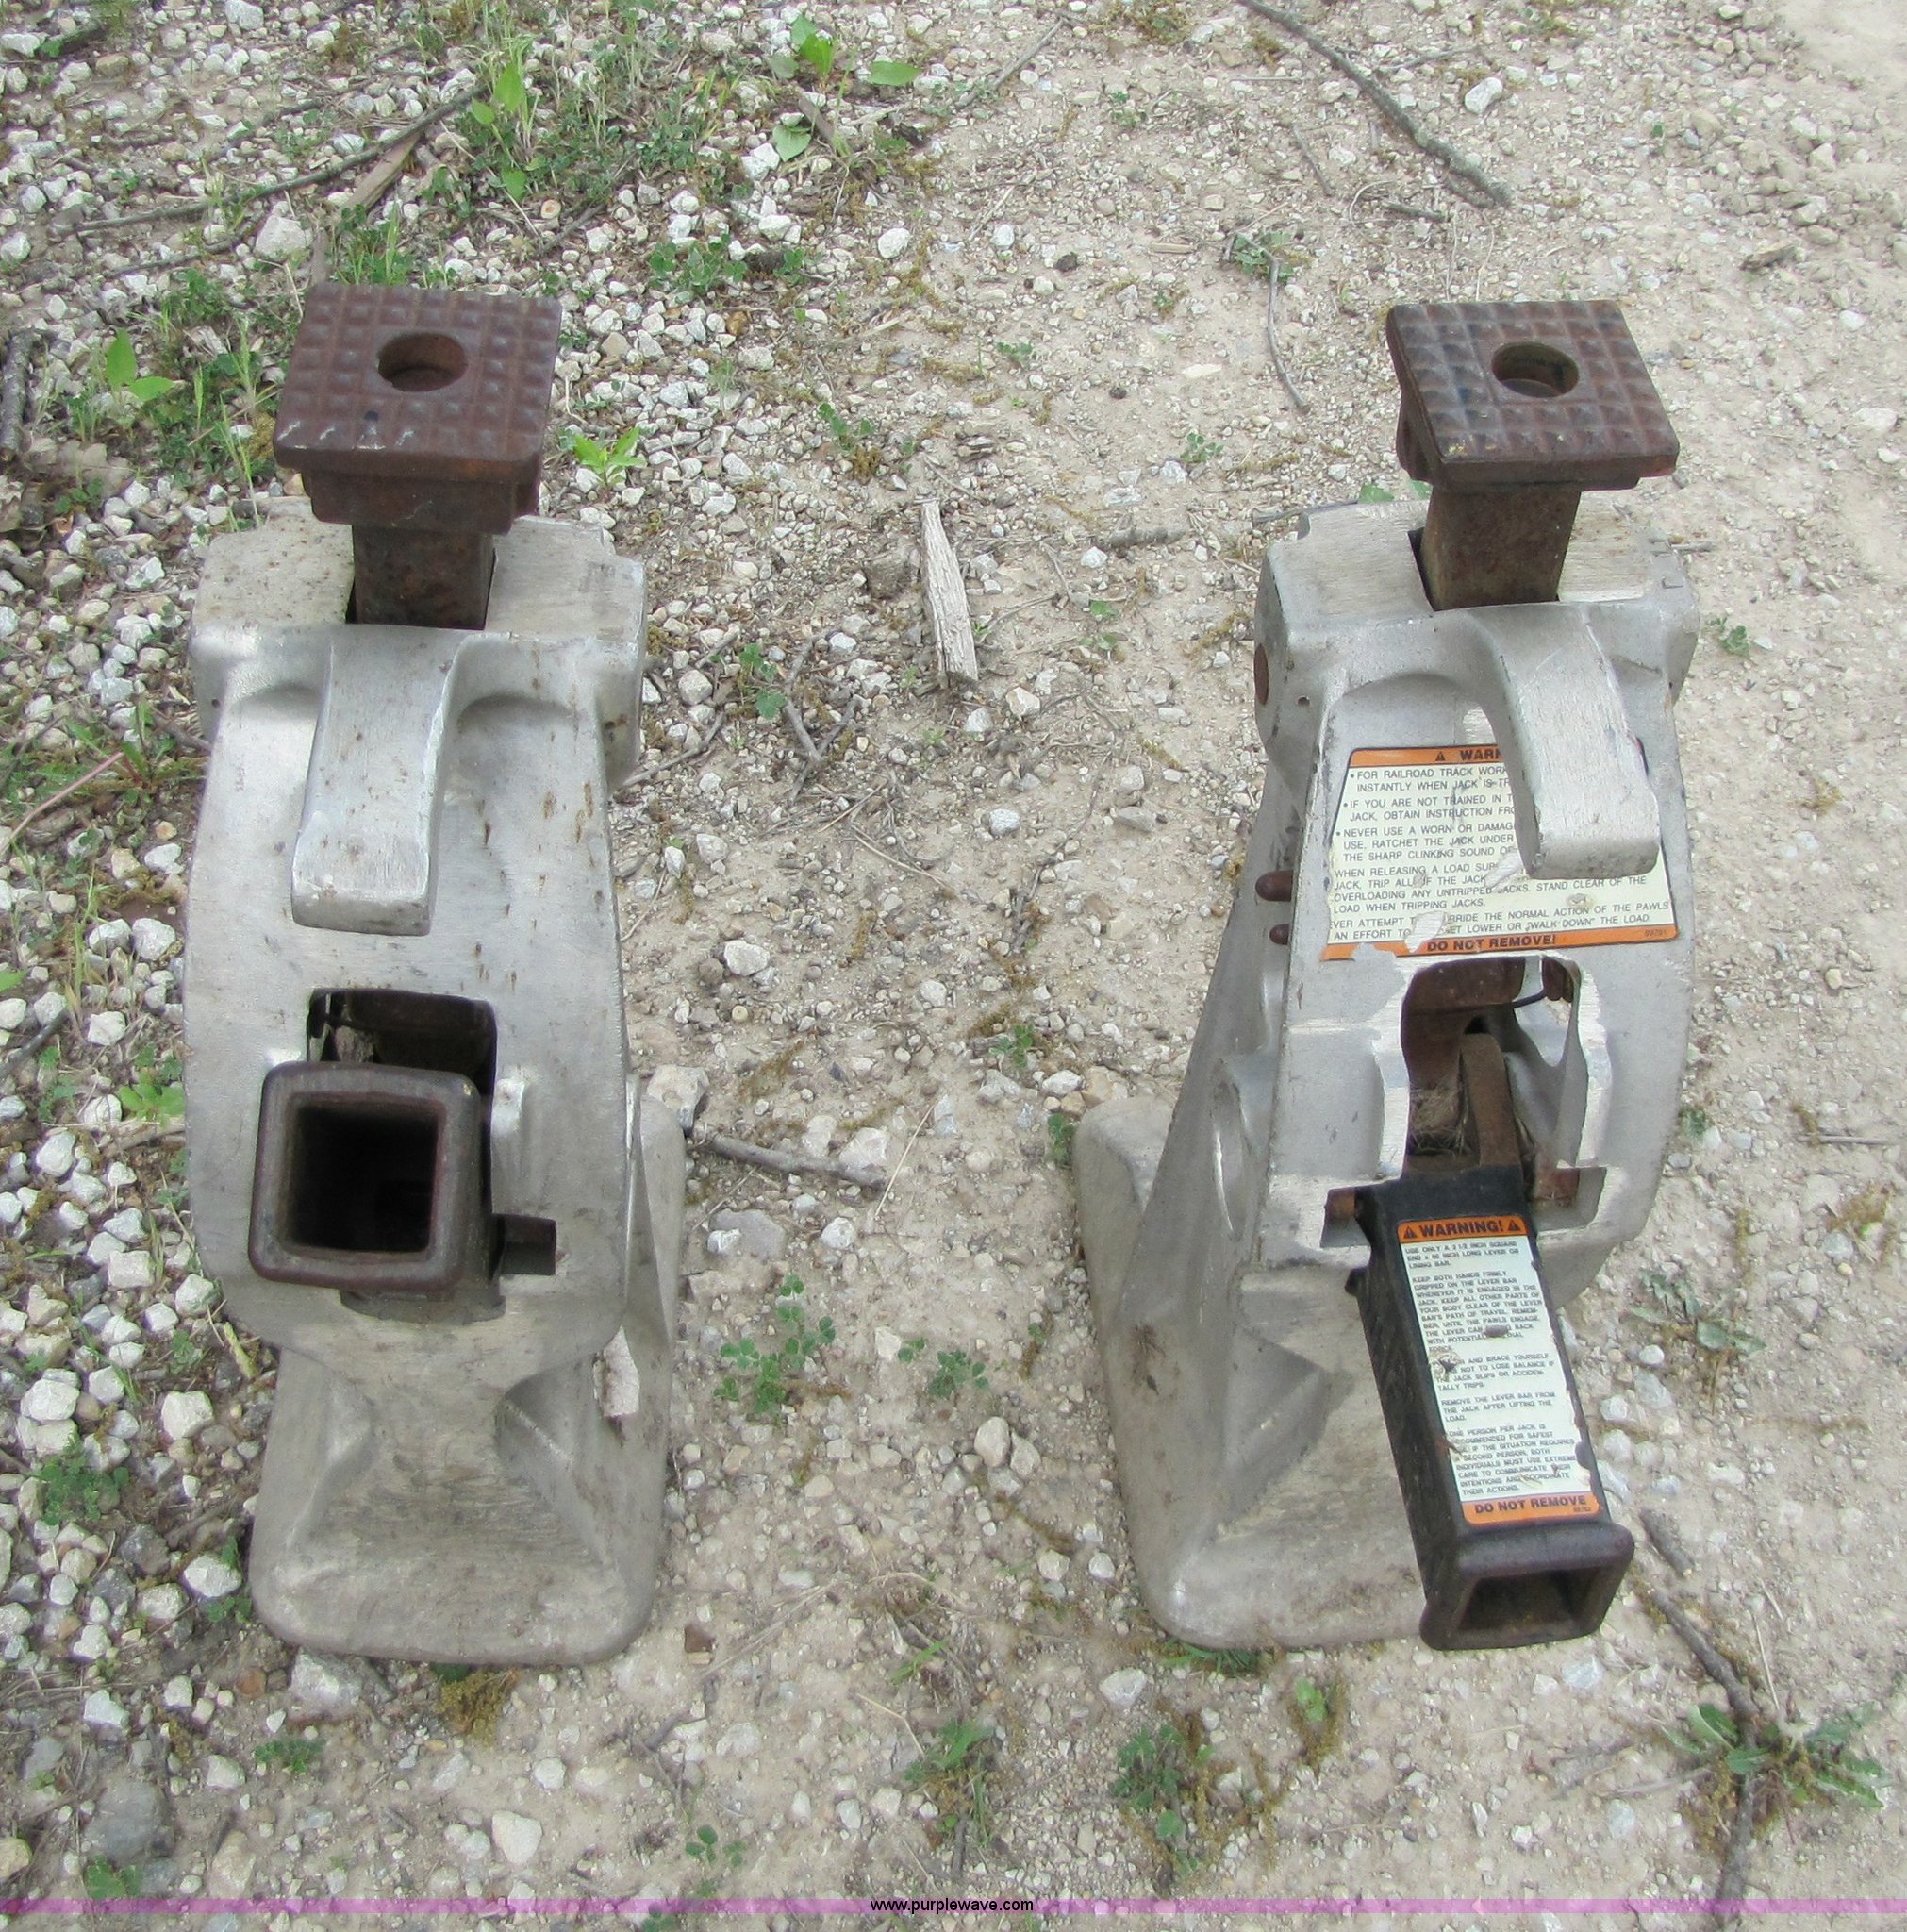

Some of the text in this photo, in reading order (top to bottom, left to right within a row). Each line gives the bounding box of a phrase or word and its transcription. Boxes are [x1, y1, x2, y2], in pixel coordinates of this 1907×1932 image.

[1460, 749, 1502, 761] WARN
[1357, 770, 1377, 779] FOR
[1384, 769, 1434, 778] RAILROAD
[1440, 768, 1473, 777] TRACK
[1357, 782, 1411, 792] INSTANTLY
[1417, 781, 1447, 790] WHEN
[1453, 779, 1477, 789] JACK
[1365, 799, 1386, 808] YOU
[1392, 798, 1411, 807] ARE
[1417, 797, 1437, 806] NOT
[1444, 795, 1486, 805] TRAINED
[1383, 810, 1420, 820] OBTAIN
[1426, 808, 1492, 818] INSTRUCTION
[1344, 823, 1513, 838] NEVER USE A WORN OR DAMAG
[1372, 838, 1418, 849] RATCHET
[1425, 837, 1443, 846] THE
[1449, 835, 1474, 846] JACK
[1480, 834, 1513, 844] UNDER
[1344, 853, 1363, 862] THE
[1368, 851, 1402, 861] SHARP
[1408, 849, 1454, 859] CLINKING
[1460, 847, 1494, 857] SOUND
[1335, 869, 1365, 878] WHEN
[1370, 865, 1426, 877] RELEASING
[1432, 865, 1438, 873] A
[1444, 864, 1469, 873] LOAD
[1334, 890, 1406, 902] OVERLOADING
[1412, 889, 1431, 898] ANY
[1437, 887, 1492, 897] UNTRIPPED
[1536, 881, 1568, 891] STAND
[1573, 879, 1603, 889] CLEAR
[1610, 877, 1622, 886] OF
[1628, 876, 1646, 885] THE
[1368, 879, 1389, 888] TRIP
[1395, 878, 1413, 887] ALL
[1438, 876, 1456, 884] THE
[1334, 899, 1486, 913] LOAD WHEN TRIPPING JACKS.
[1358, 917, 1404, 927] ATTEMPT
[1484, 912, 1502, 921] THE
[1508, 909, 1549, 919] NORMAL
[1554, 906, 1589, 917] ACTION
[1594, 905, 1607, 914] OF
[1613, 904, 1630, 912] THE
[1637, 901, 1669, 911] PAWLS
[1334, 931, 1347, 940] AN
[1353, 929, 1390, 939] EFFORT
[1467, 923, 1502, 933] LOWER
[1508, 922, 1522, 930] OR
[1624, 914, 1651, 923] LOAD.
[1427, 934, 1556, 951] DO NOT REMOVE!
[1419, 1221, 1503, 1237] WARNING!
[1475, 1495, 1586, 1513] DO NOT REMOVE
